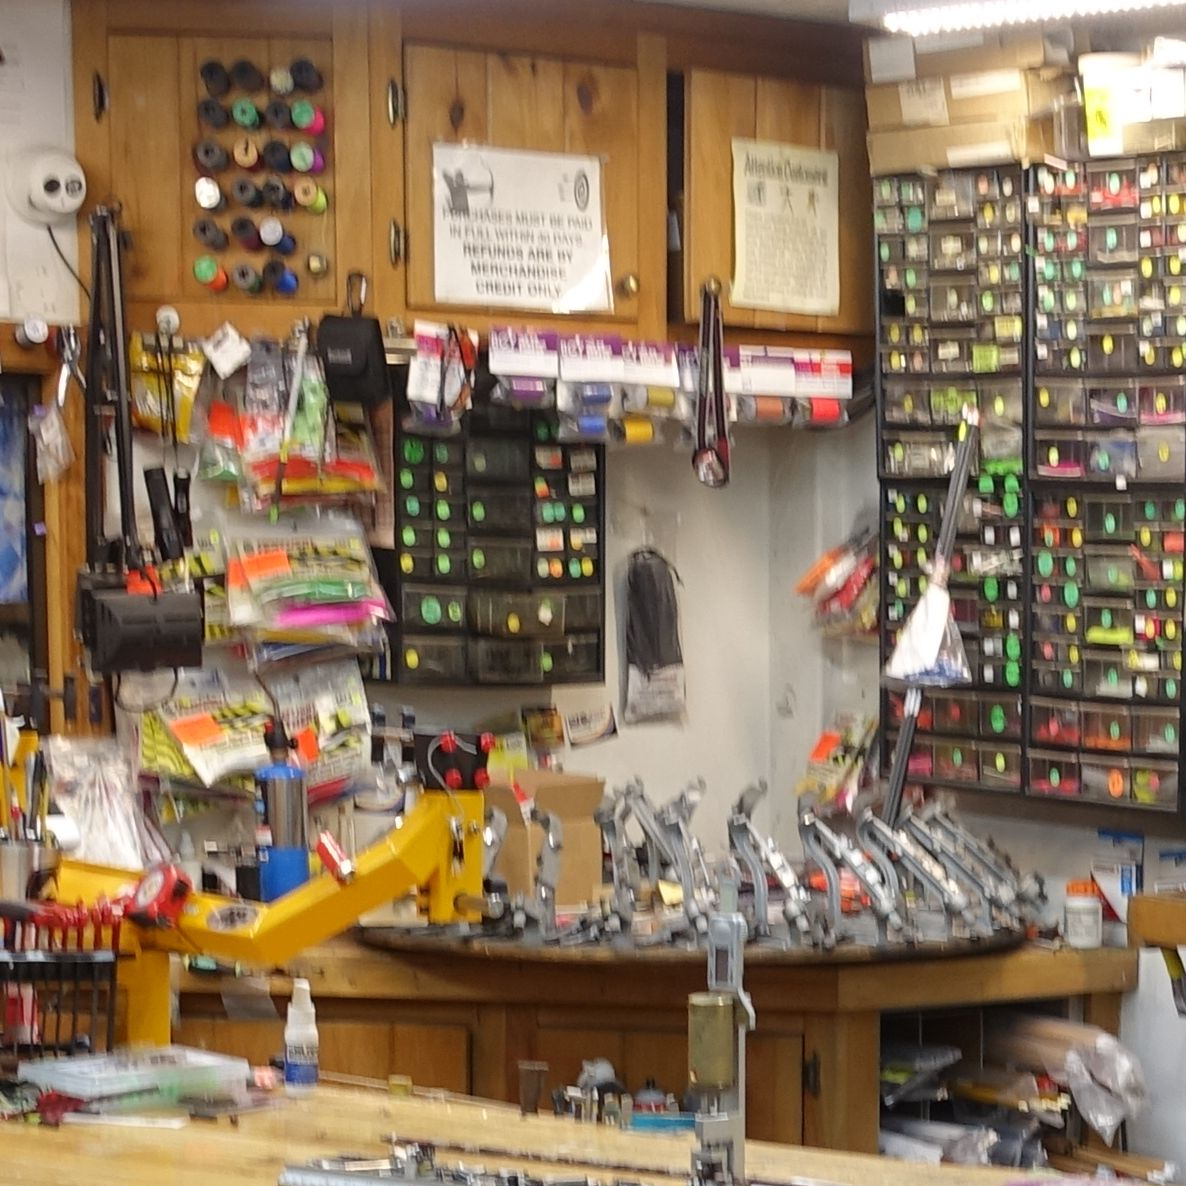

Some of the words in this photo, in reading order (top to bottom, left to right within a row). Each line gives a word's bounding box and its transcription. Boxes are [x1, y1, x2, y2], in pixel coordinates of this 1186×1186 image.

[515, 211, 546, 227] MUST
[549, 214, 564, 228] BE
[567, 215, 593, 231] PAID
[465, 225, 491, 241] FULL
[494, 227, 535, 245] WITHIN
[553, 232, 583, 247] DAYS
[463, 242, 524, 260] REFUNDS
[527, 246, 553, 262] ARE
[557, 248, 573, 263] BY
[470, 260, 566, 280] MERCHANDISE
[475, 279, 523, 297] CREDIT
[527, 282, 561, 299] ONLY
